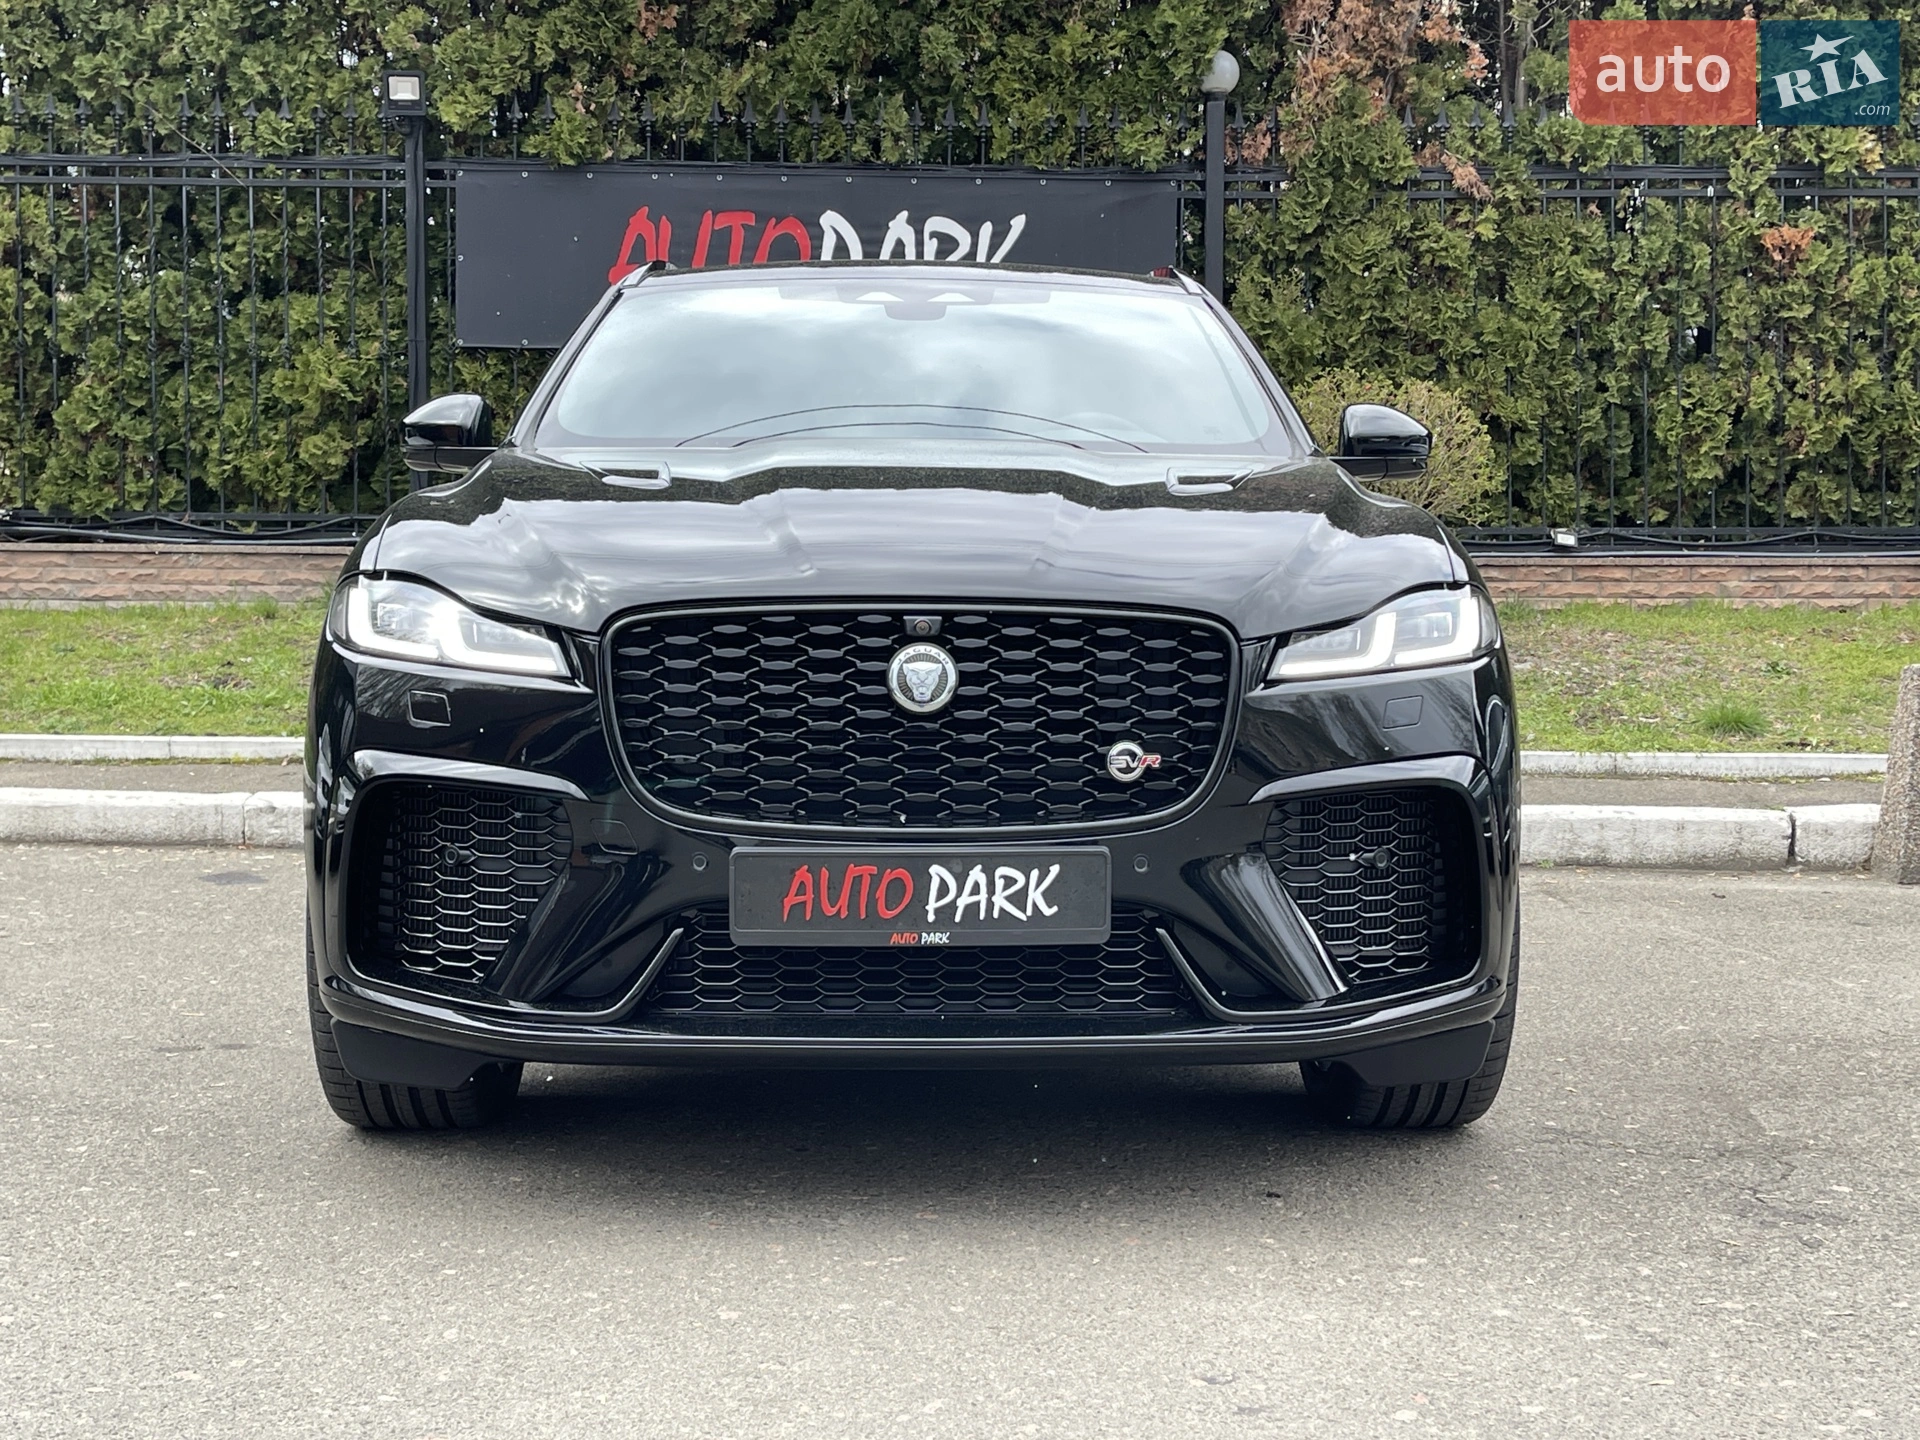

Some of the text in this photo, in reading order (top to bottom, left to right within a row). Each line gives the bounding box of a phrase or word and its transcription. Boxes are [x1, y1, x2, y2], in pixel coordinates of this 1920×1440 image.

[608, 206, 812, 285] AUTO
[897, 647, 949, 666] JAGUAR
[1110, 755, 1161, 768] SVR
[782, 863, 1061, 923] AUTO PARK
[890, 931, 950, 945] AUTO PARK
